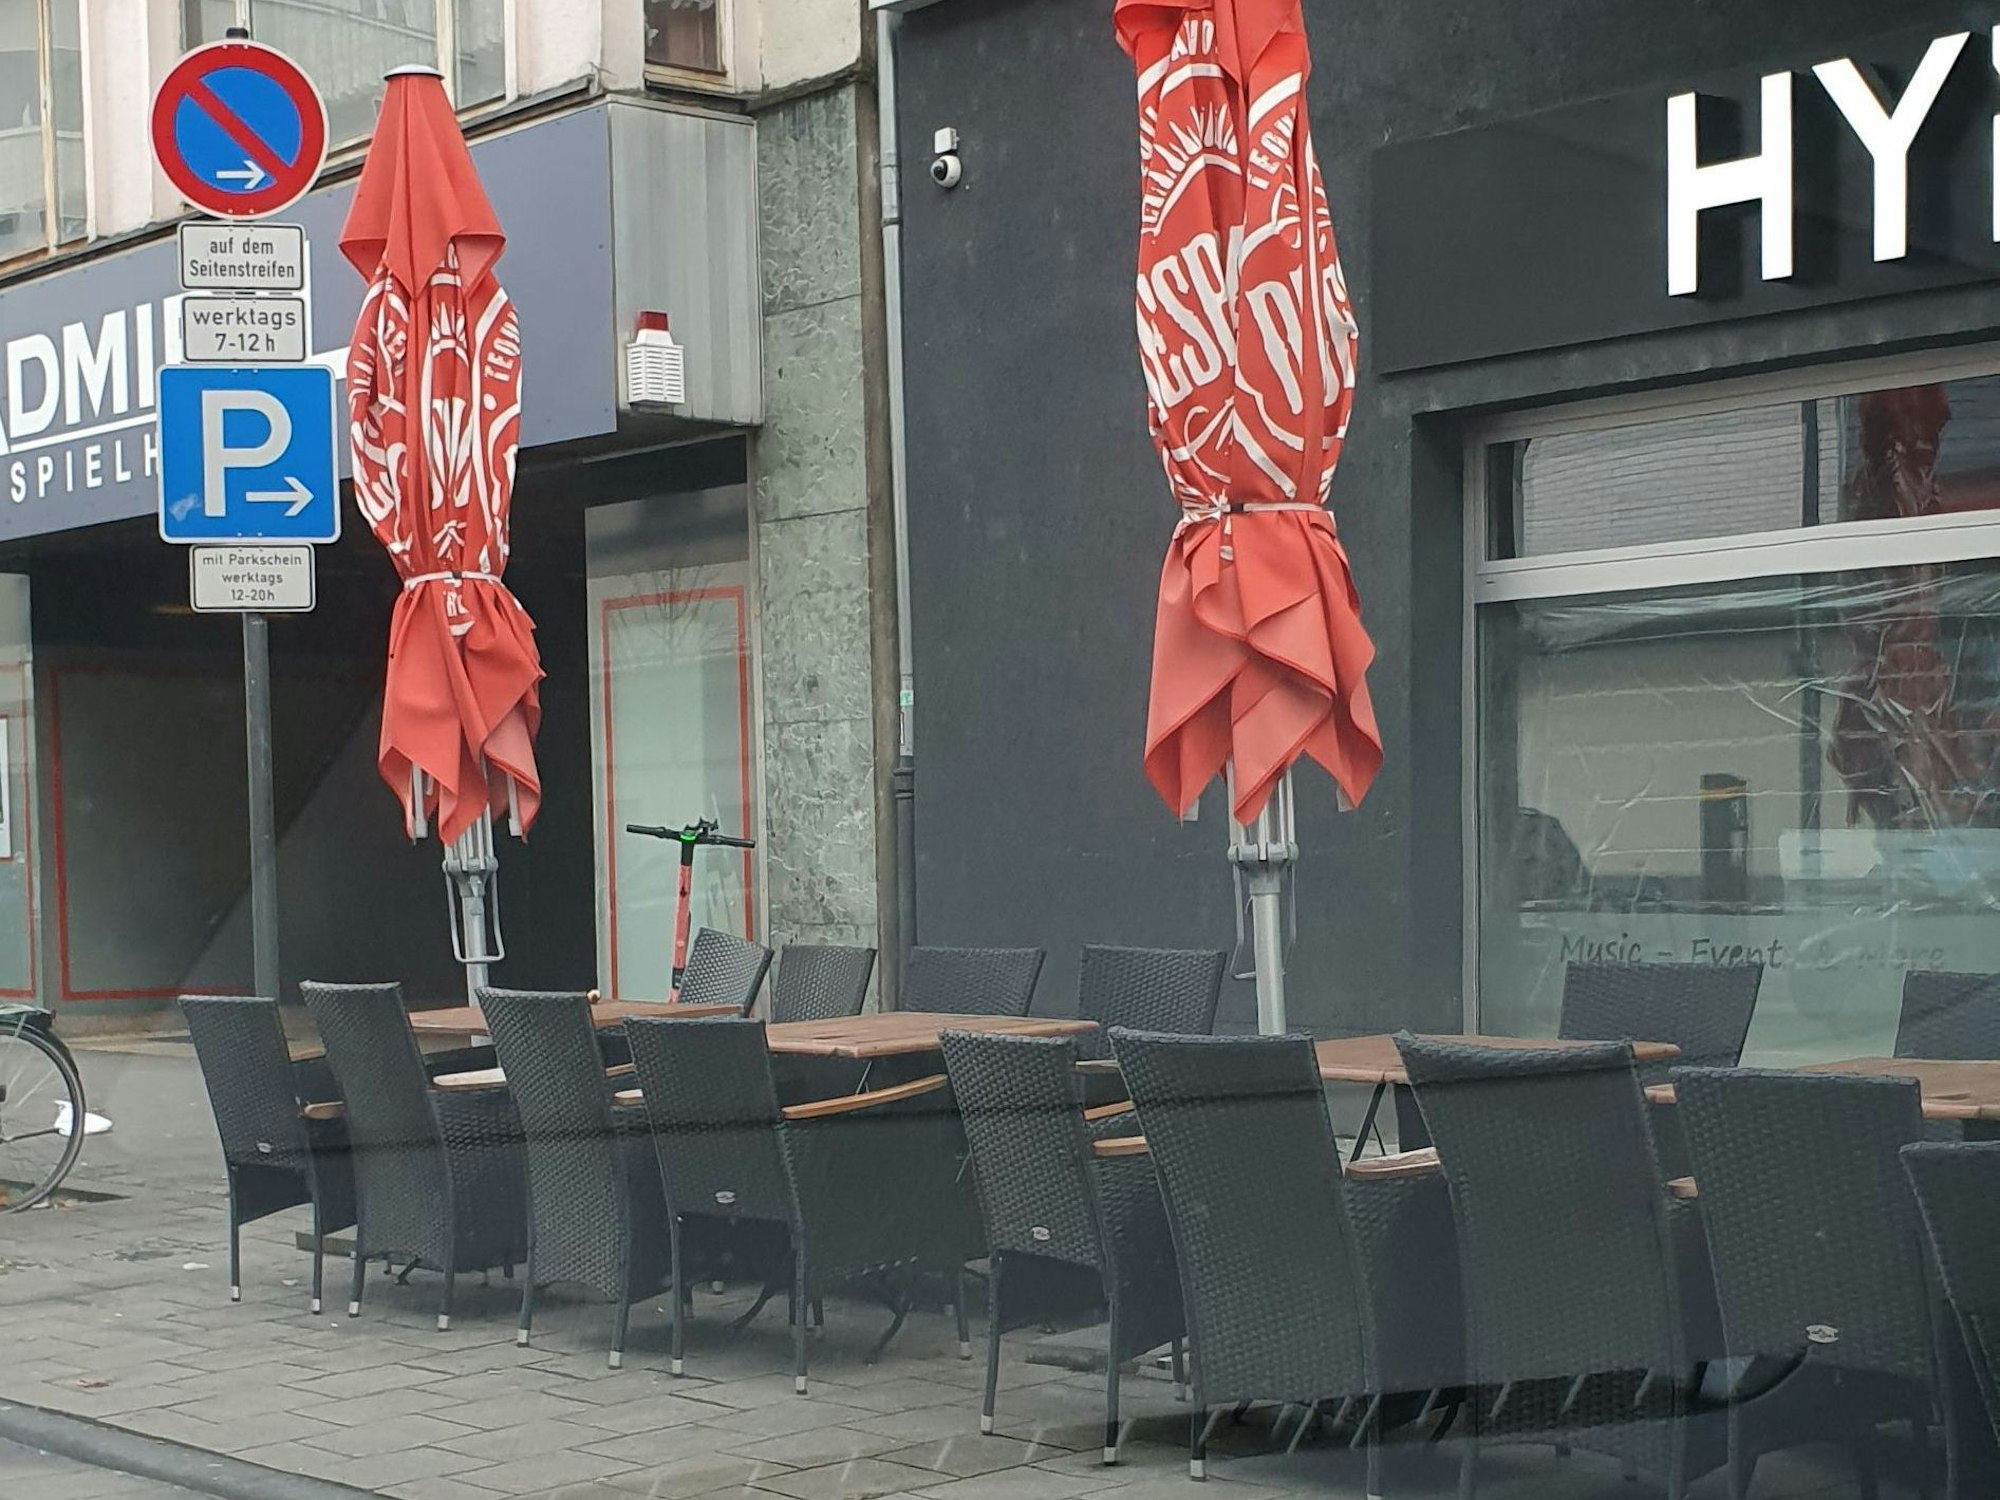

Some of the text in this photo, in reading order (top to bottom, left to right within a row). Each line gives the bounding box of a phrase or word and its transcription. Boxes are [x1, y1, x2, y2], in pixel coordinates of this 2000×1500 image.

[209, 236, 274, 255] auf dem
[190, 259, 295, 278] Seitenstreifen
[192, 307, 296, 331] werktags
[201, 390, 292, 517] P
[202, 553, 302, 566] mit Parkschein
[222, 572, 284, 587] werktags
[1560, 932, 1642, 966] Music
[1692, 938, 1784, 969] Event
